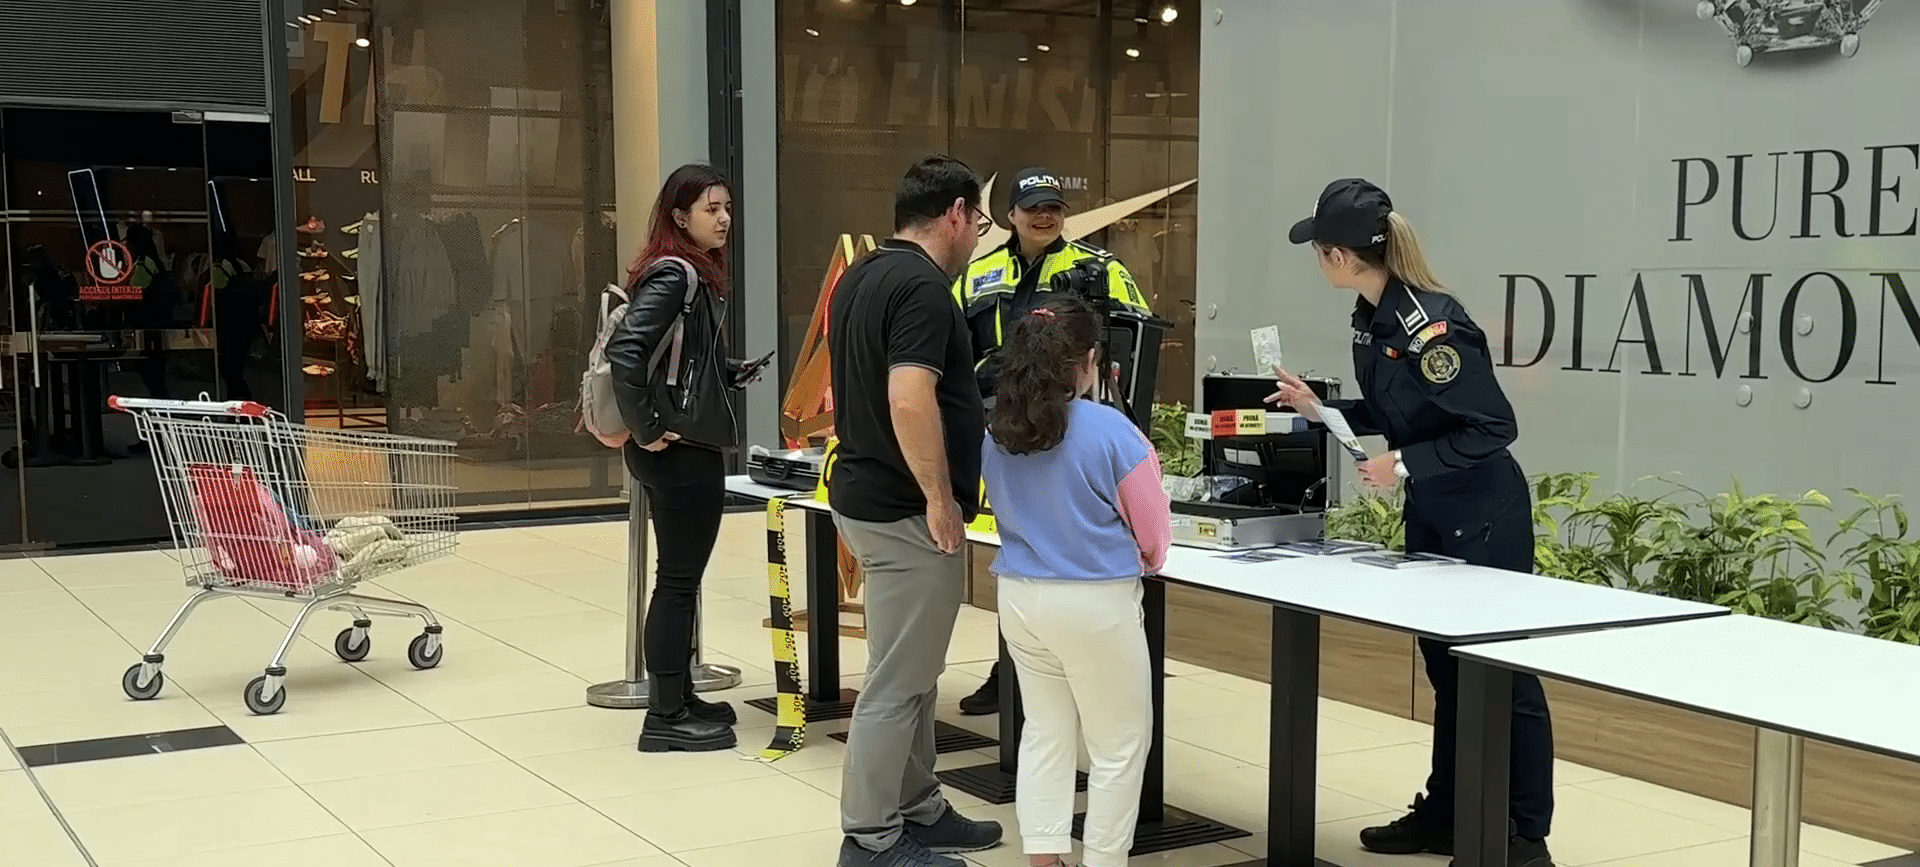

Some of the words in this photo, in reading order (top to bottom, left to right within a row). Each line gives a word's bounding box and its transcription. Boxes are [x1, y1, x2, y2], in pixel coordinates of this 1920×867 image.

[1668, 144, 1920, 242] PURE
[777, 538, 784, 552] 80
[779, 571, 786, 584] 70
[782, 604, 790, 618] 60
[785, 636, 792, 649] 50
[793, 700, 801, 713] 30
[789, 733, 800, 745] 20
